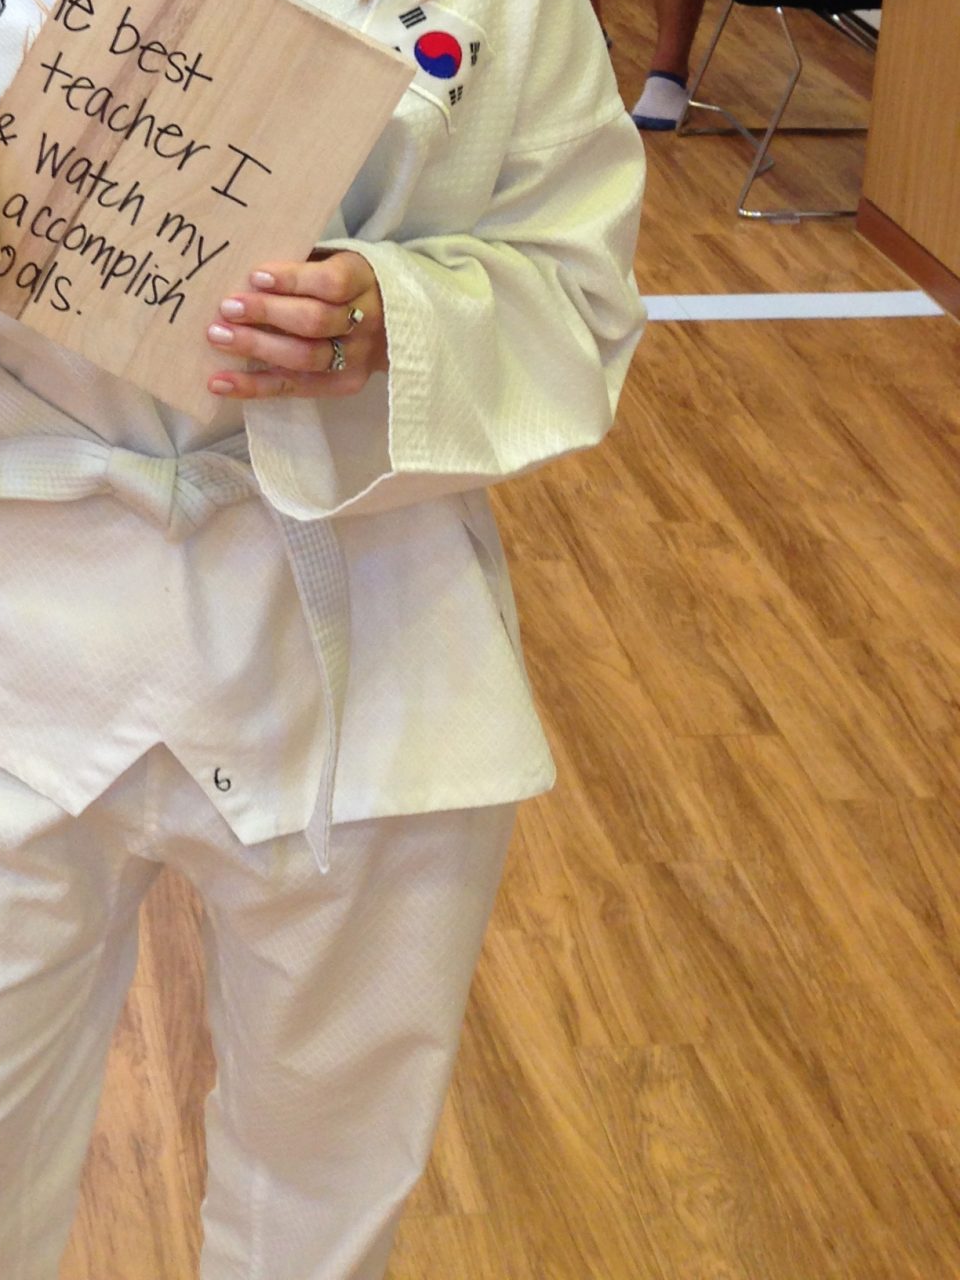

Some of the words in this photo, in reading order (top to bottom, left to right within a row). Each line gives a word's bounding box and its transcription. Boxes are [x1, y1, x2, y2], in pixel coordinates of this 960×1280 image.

[108, 6, 214, 92] best
[40, 51, 211, 171] teacher
[210, 143, 273, 208] I
[2, 193, 186, 324] accomplish
[155, 211, 230, 281] my
[213, 766, 232, 793] 6
